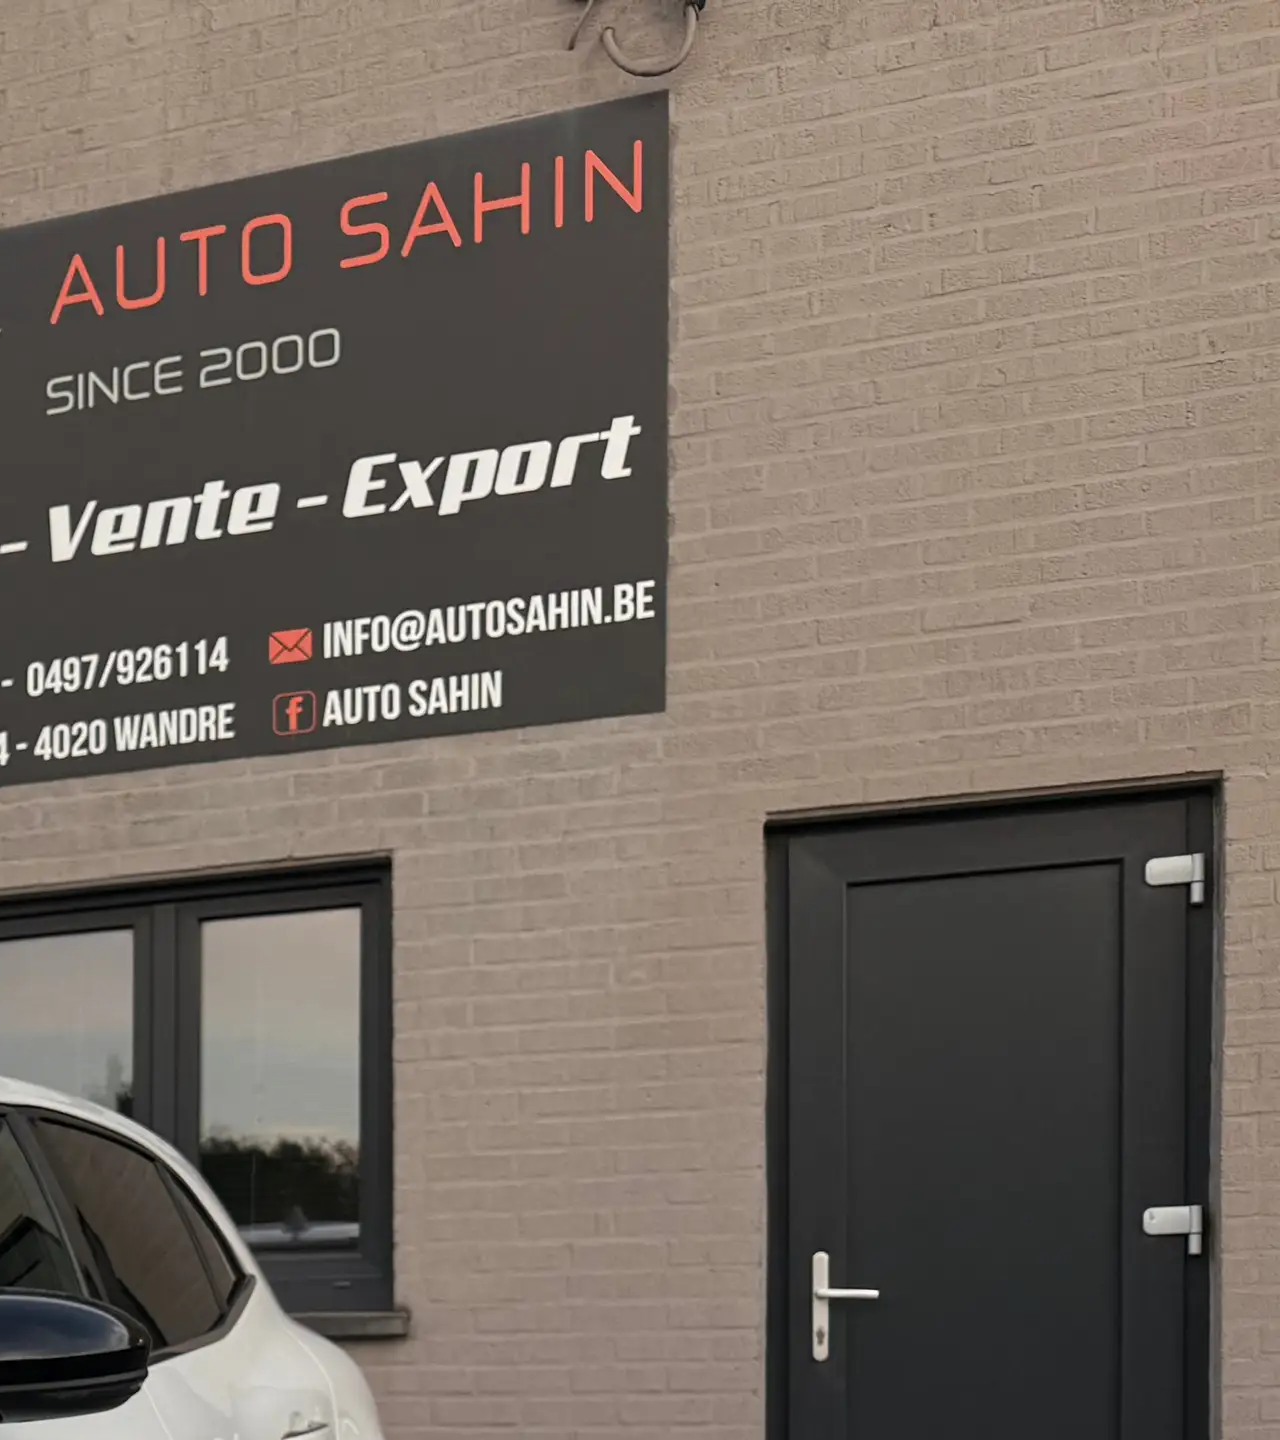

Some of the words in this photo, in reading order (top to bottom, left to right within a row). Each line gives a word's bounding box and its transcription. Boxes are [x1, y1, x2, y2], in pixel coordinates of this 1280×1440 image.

[50, 213, 294, 326] AUTO
[339, 139, 644, 270] SAHIN
[46, 355, 183, 416] SINCE
[199, 327, 341, 389] 2000
[48, 479, 281, 563] Vente
[296, 494, 329, 509] -
[342, 414, 642, 519] Export
[323, 579, 657, 659] INFO@AUTOSAHIN.BE
[26, 635, 230, 697] 0497/926114
[322, 682, 401, 728] AUTO
[407, 669, 503, 717] SAHIN
[33, 718, 108, 761] 4020
[113, 702, 236, 752] WANDRE
